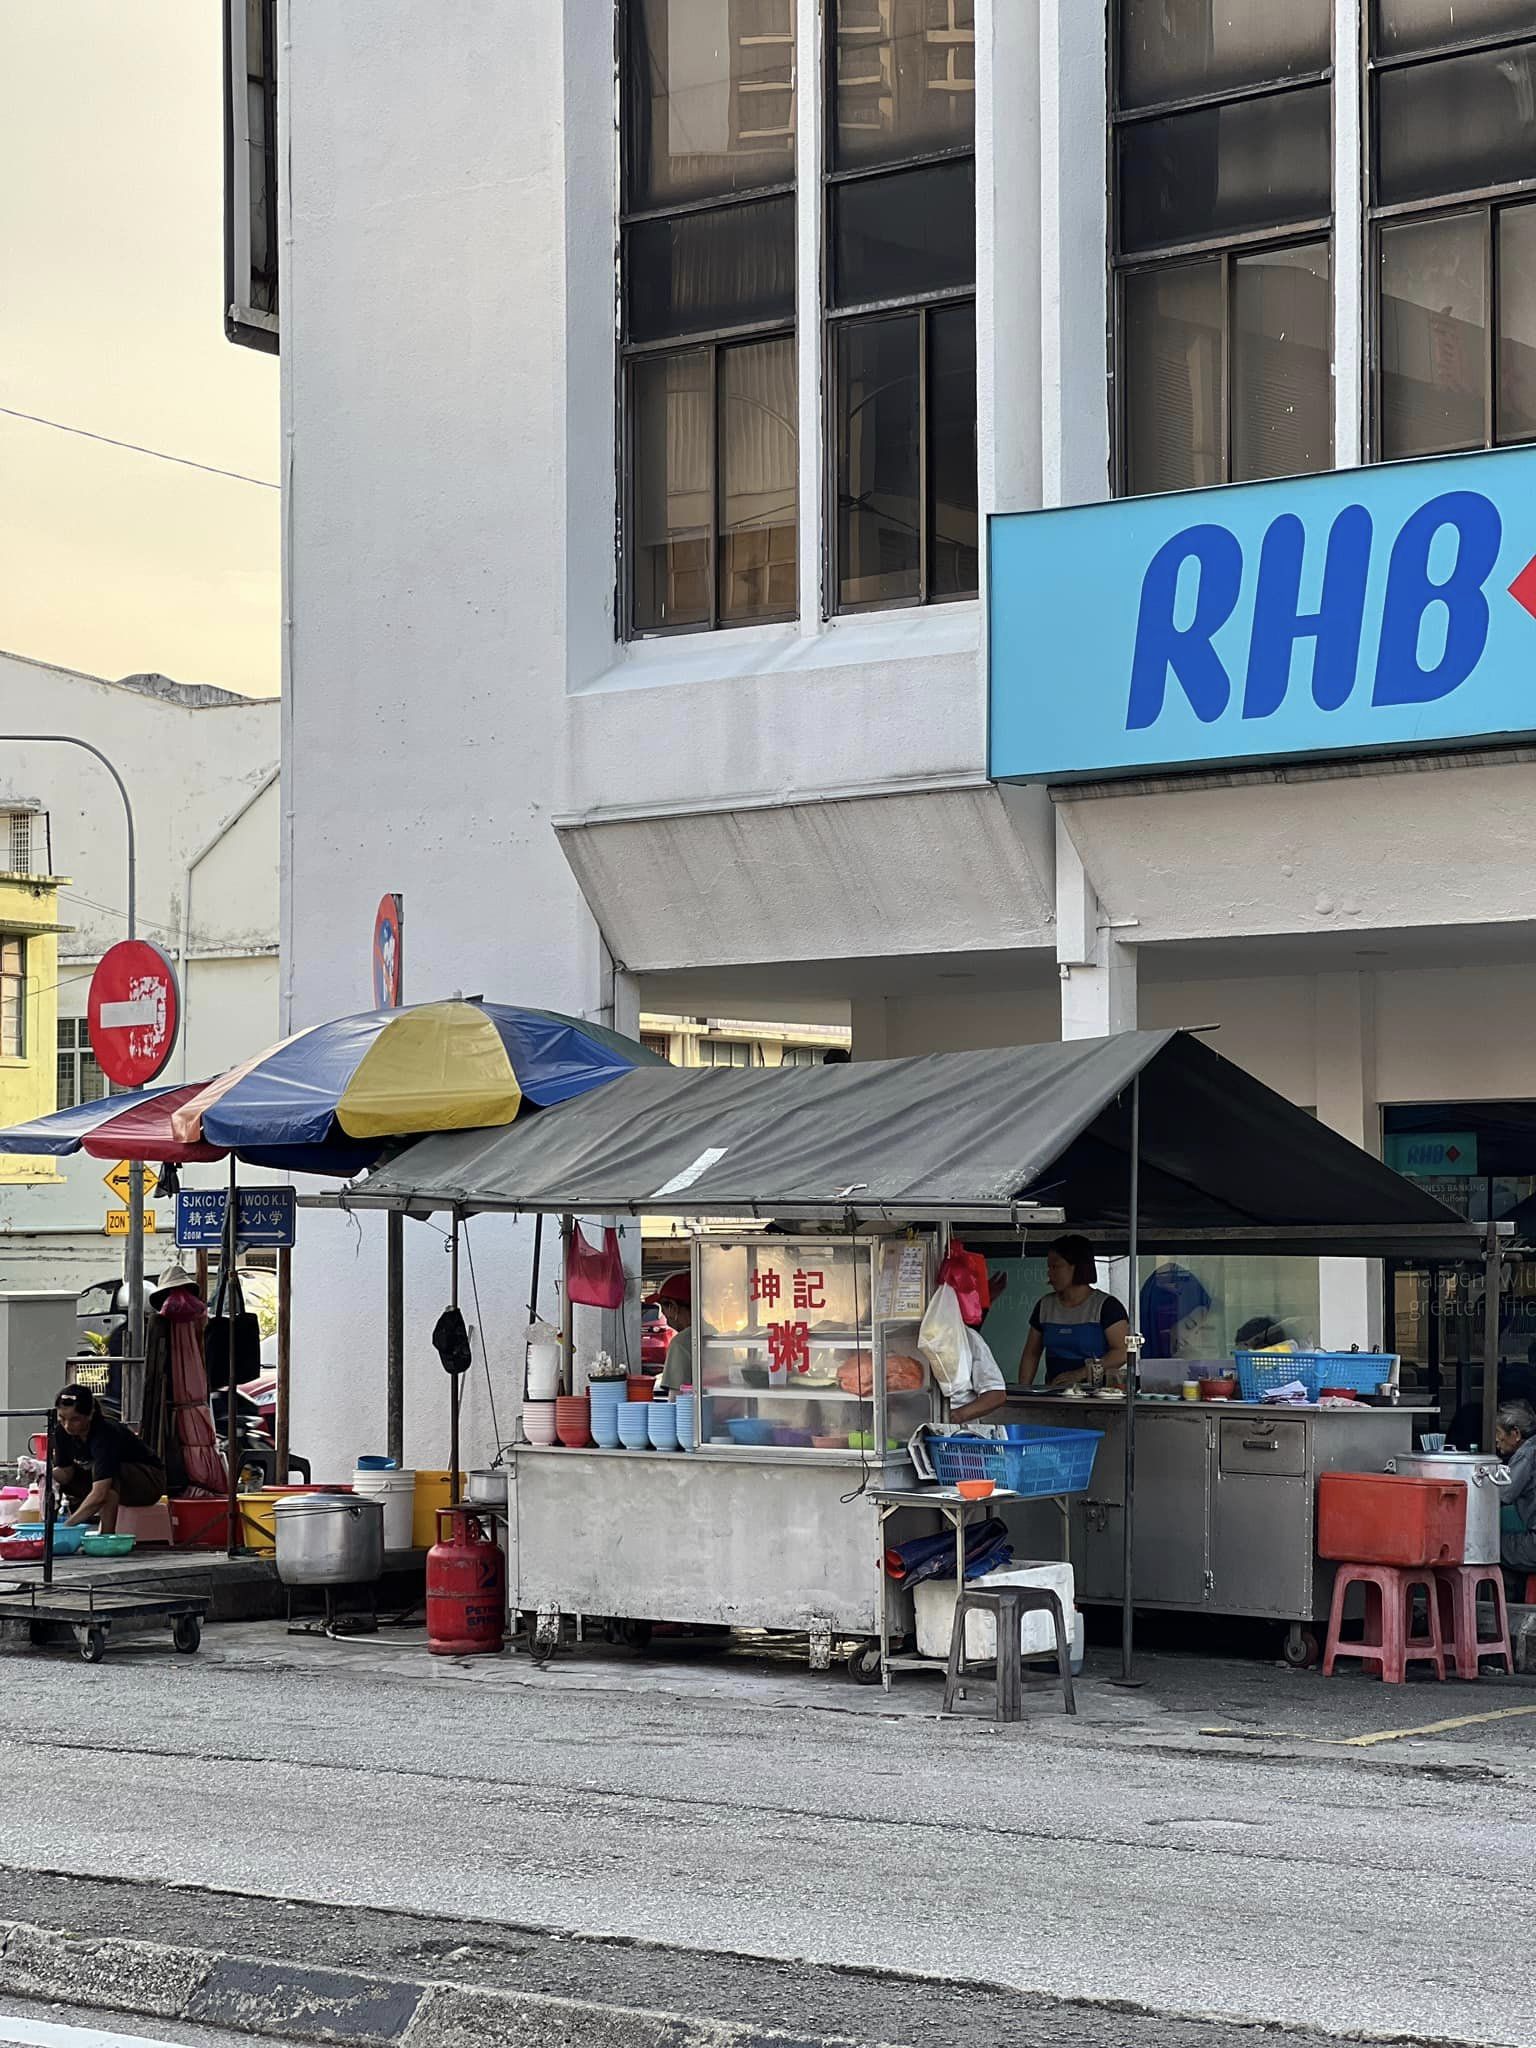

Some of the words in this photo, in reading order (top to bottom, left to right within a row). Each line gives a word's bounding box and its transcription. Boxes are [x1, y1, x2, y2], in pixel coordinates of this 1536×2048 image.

[1125, 490, 1503, 731] RHB
[182, 1195, 216, 1207] SJK(C)
[244, 1194, 269, 1206] WOO
[109, 1216, 125, 1229] ZON
[187, 1211, 284, 1226] 精武文小学
[183, 1231, 202, 1241] 200M
[750, 1268, 826, 1309] 坤記
[1409, 1297, 1485, 1321] greater
[766, 1319, 811, 1374] 粥
